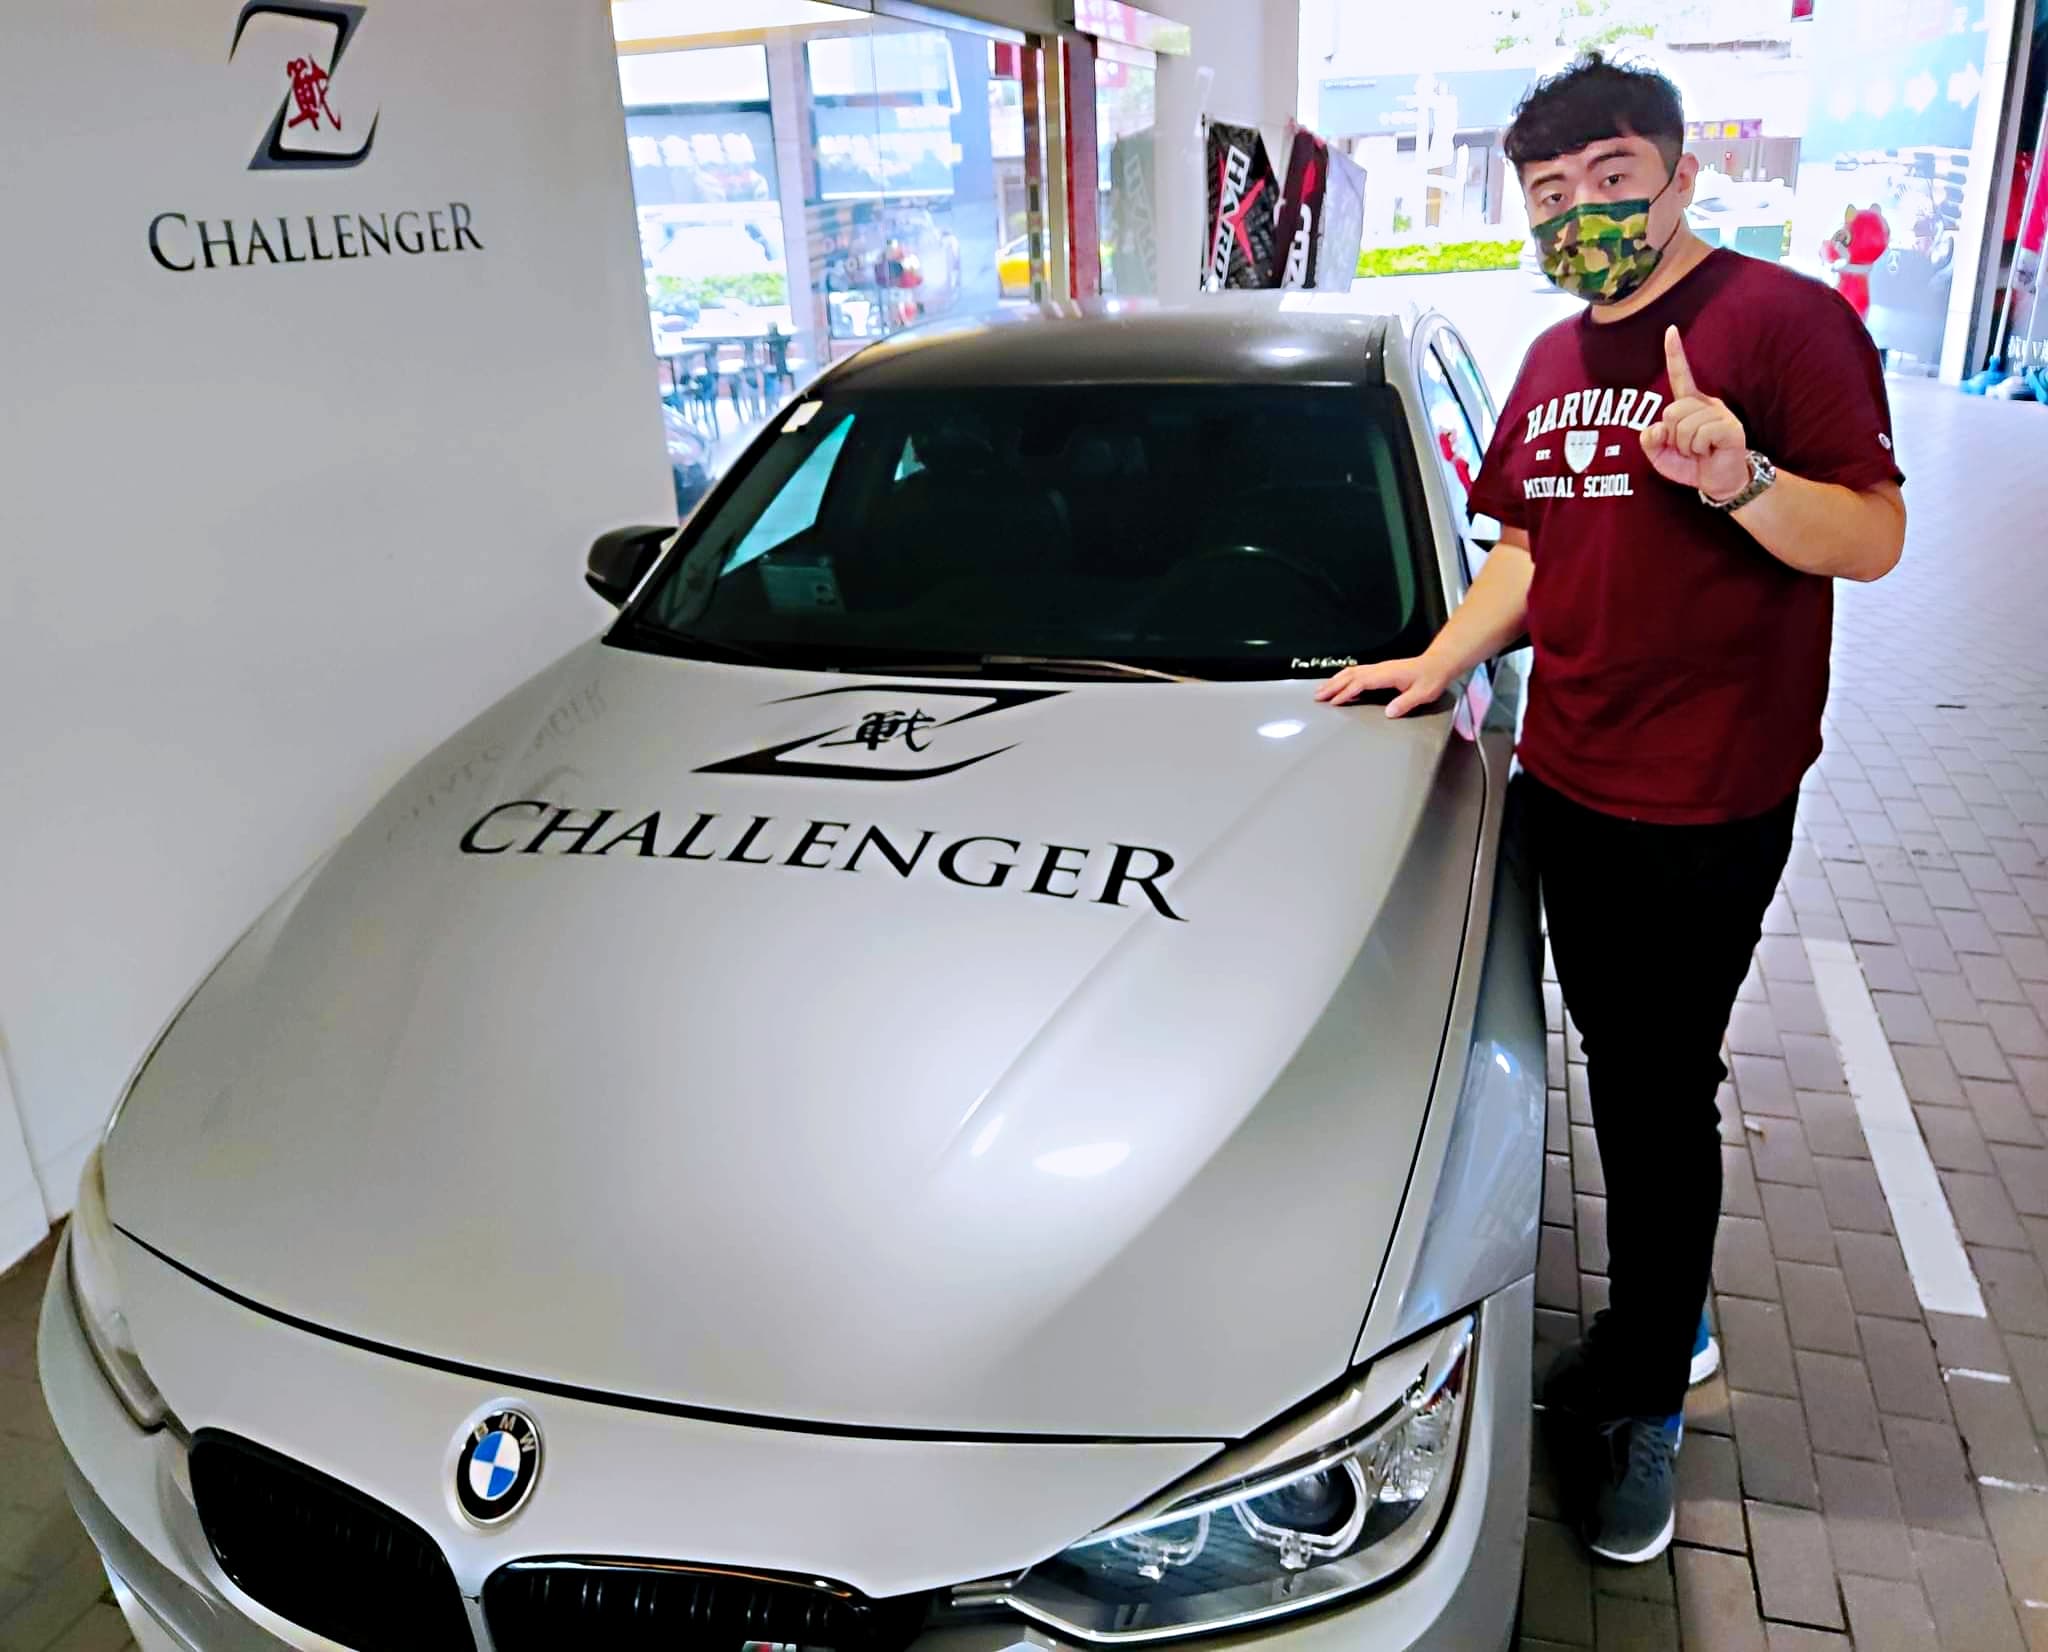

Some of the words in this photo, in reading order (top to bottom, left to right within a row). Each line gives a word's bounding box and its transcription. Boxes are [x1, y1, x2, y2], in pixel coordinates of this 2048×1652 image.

[148, 202, 484, 272] CHALLENGER
[1524, 388, 1663, 443] HARVARD
[1583, 473, 1634, 498] SCHOOL
[459, 800, 1190, 924] CHALLENGER
[473, 1412, 536, 1454] BMW
